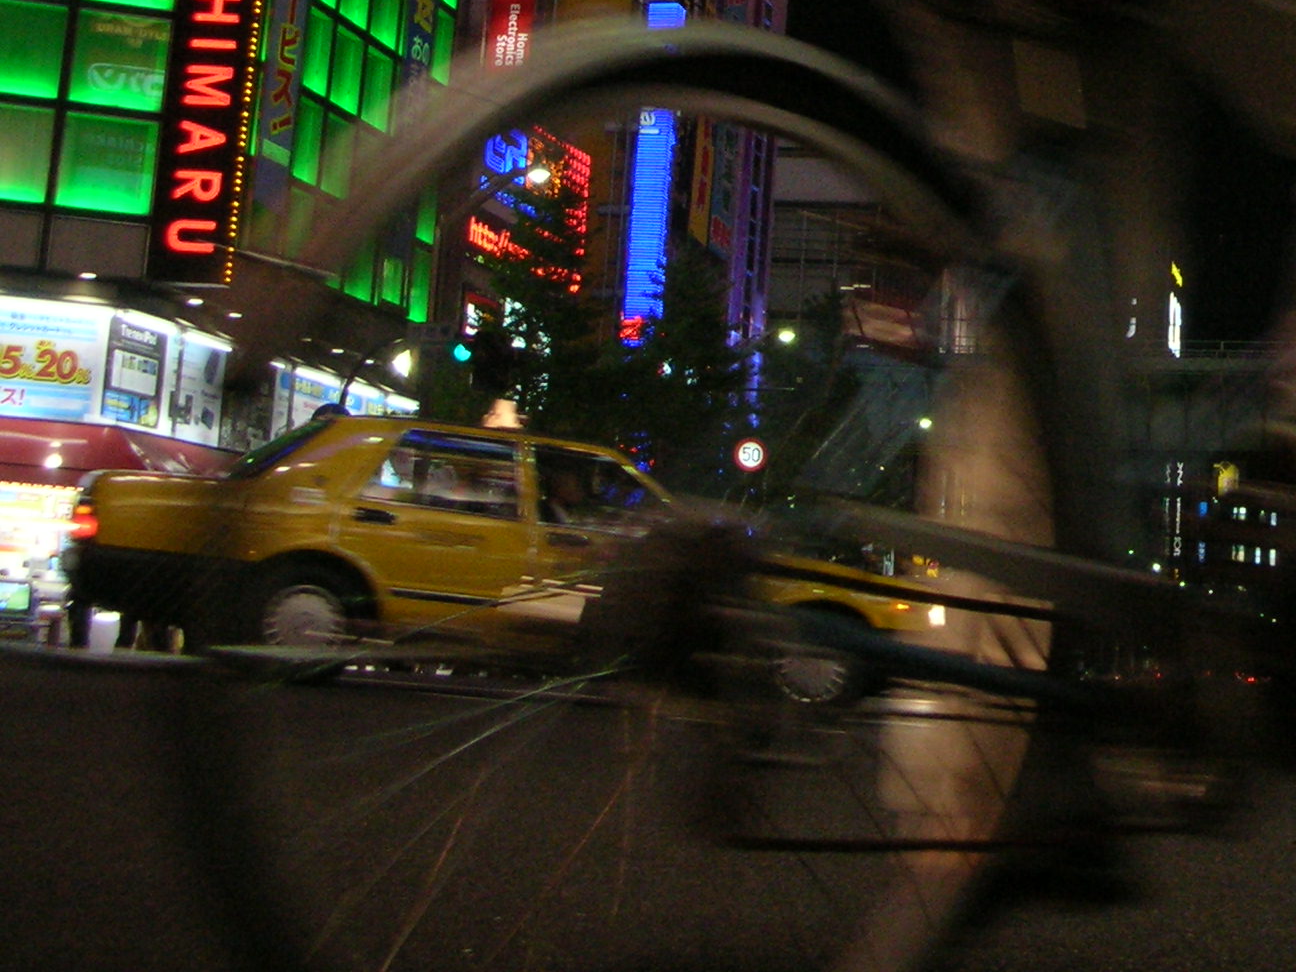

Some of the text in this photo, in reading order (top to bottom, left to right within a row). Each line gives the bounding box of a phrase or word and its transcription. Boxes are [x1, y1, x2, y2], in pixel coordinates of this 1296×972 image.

[494, 34, 508, 67] Store
[504, 3, 521, 66] Electronics
[742, 446, 761, 463] 50
